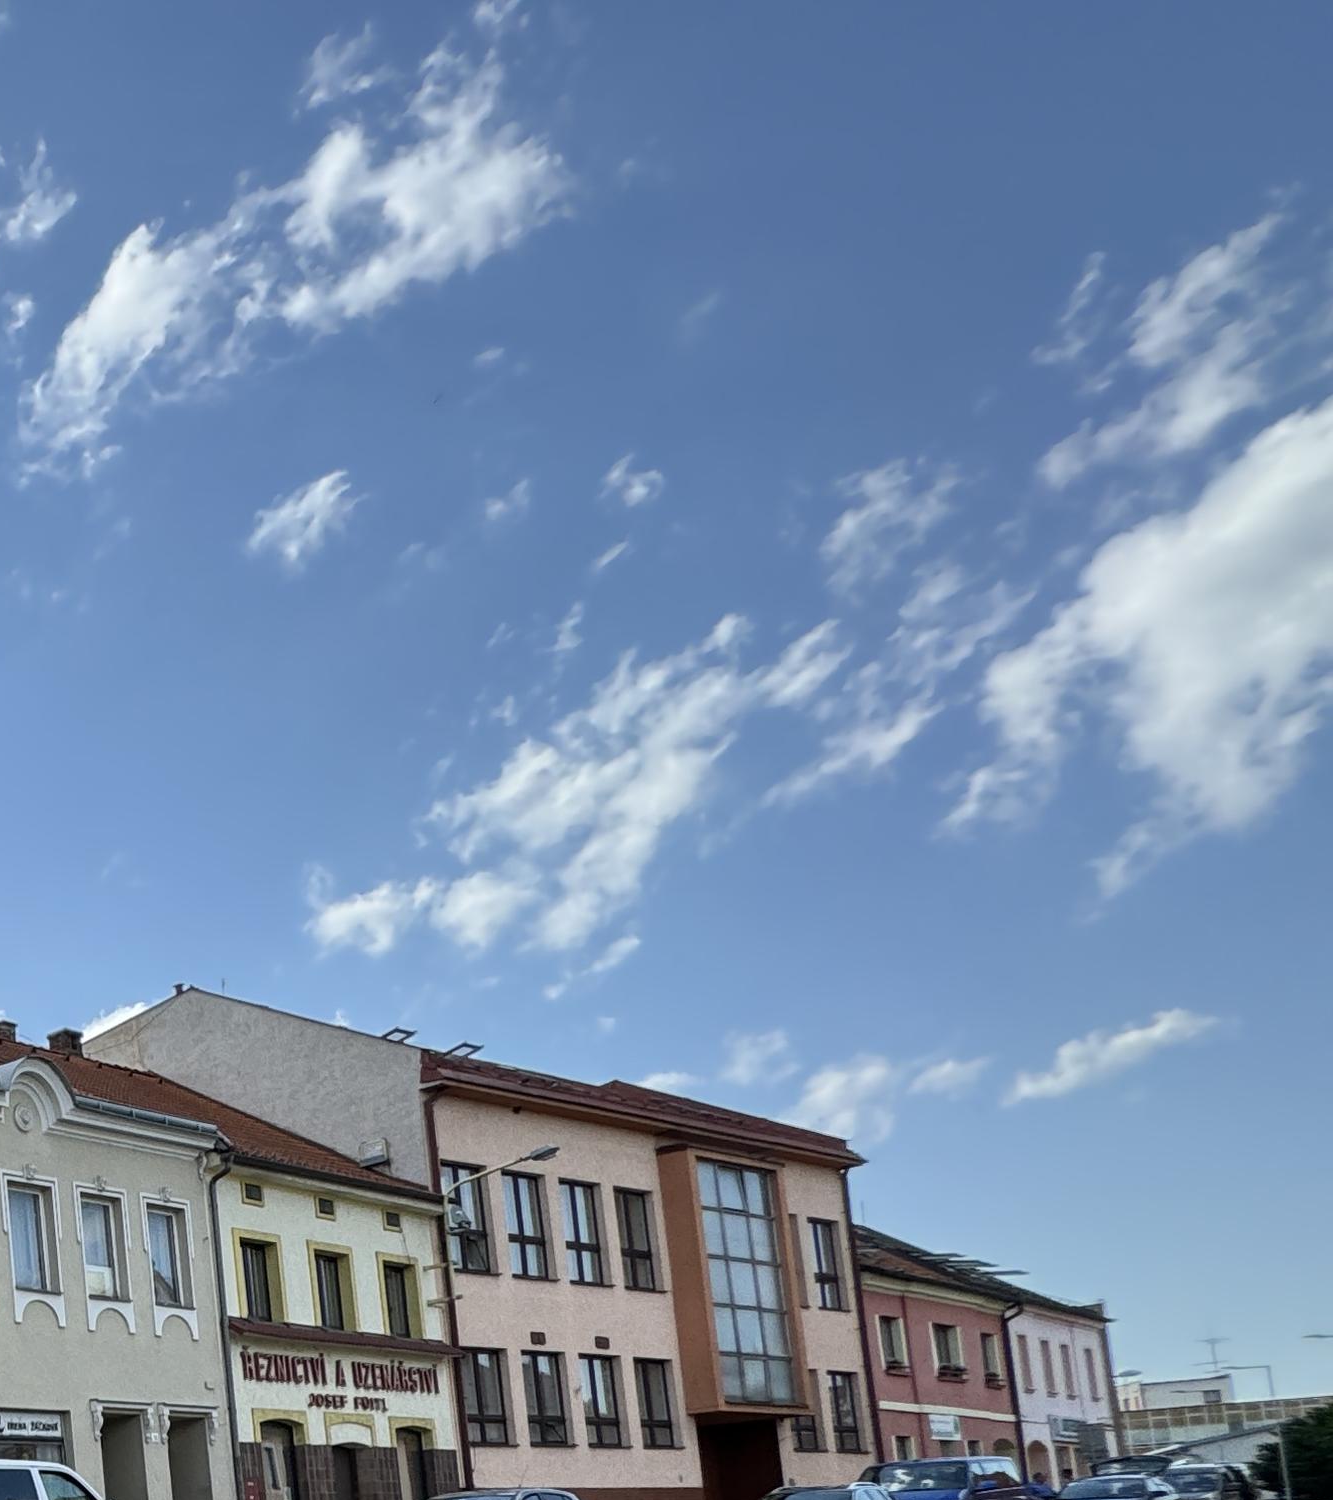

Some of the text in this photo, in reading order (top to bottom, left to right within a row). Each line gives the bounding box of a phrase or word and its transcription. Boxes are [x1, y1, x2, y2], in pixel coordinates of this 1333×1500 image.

[240, 1345, 440, 1394] ŘEZNICTVÍ A UZENÁŘSTVÍ
[307, 1393, 348, 1409] JOSEF
